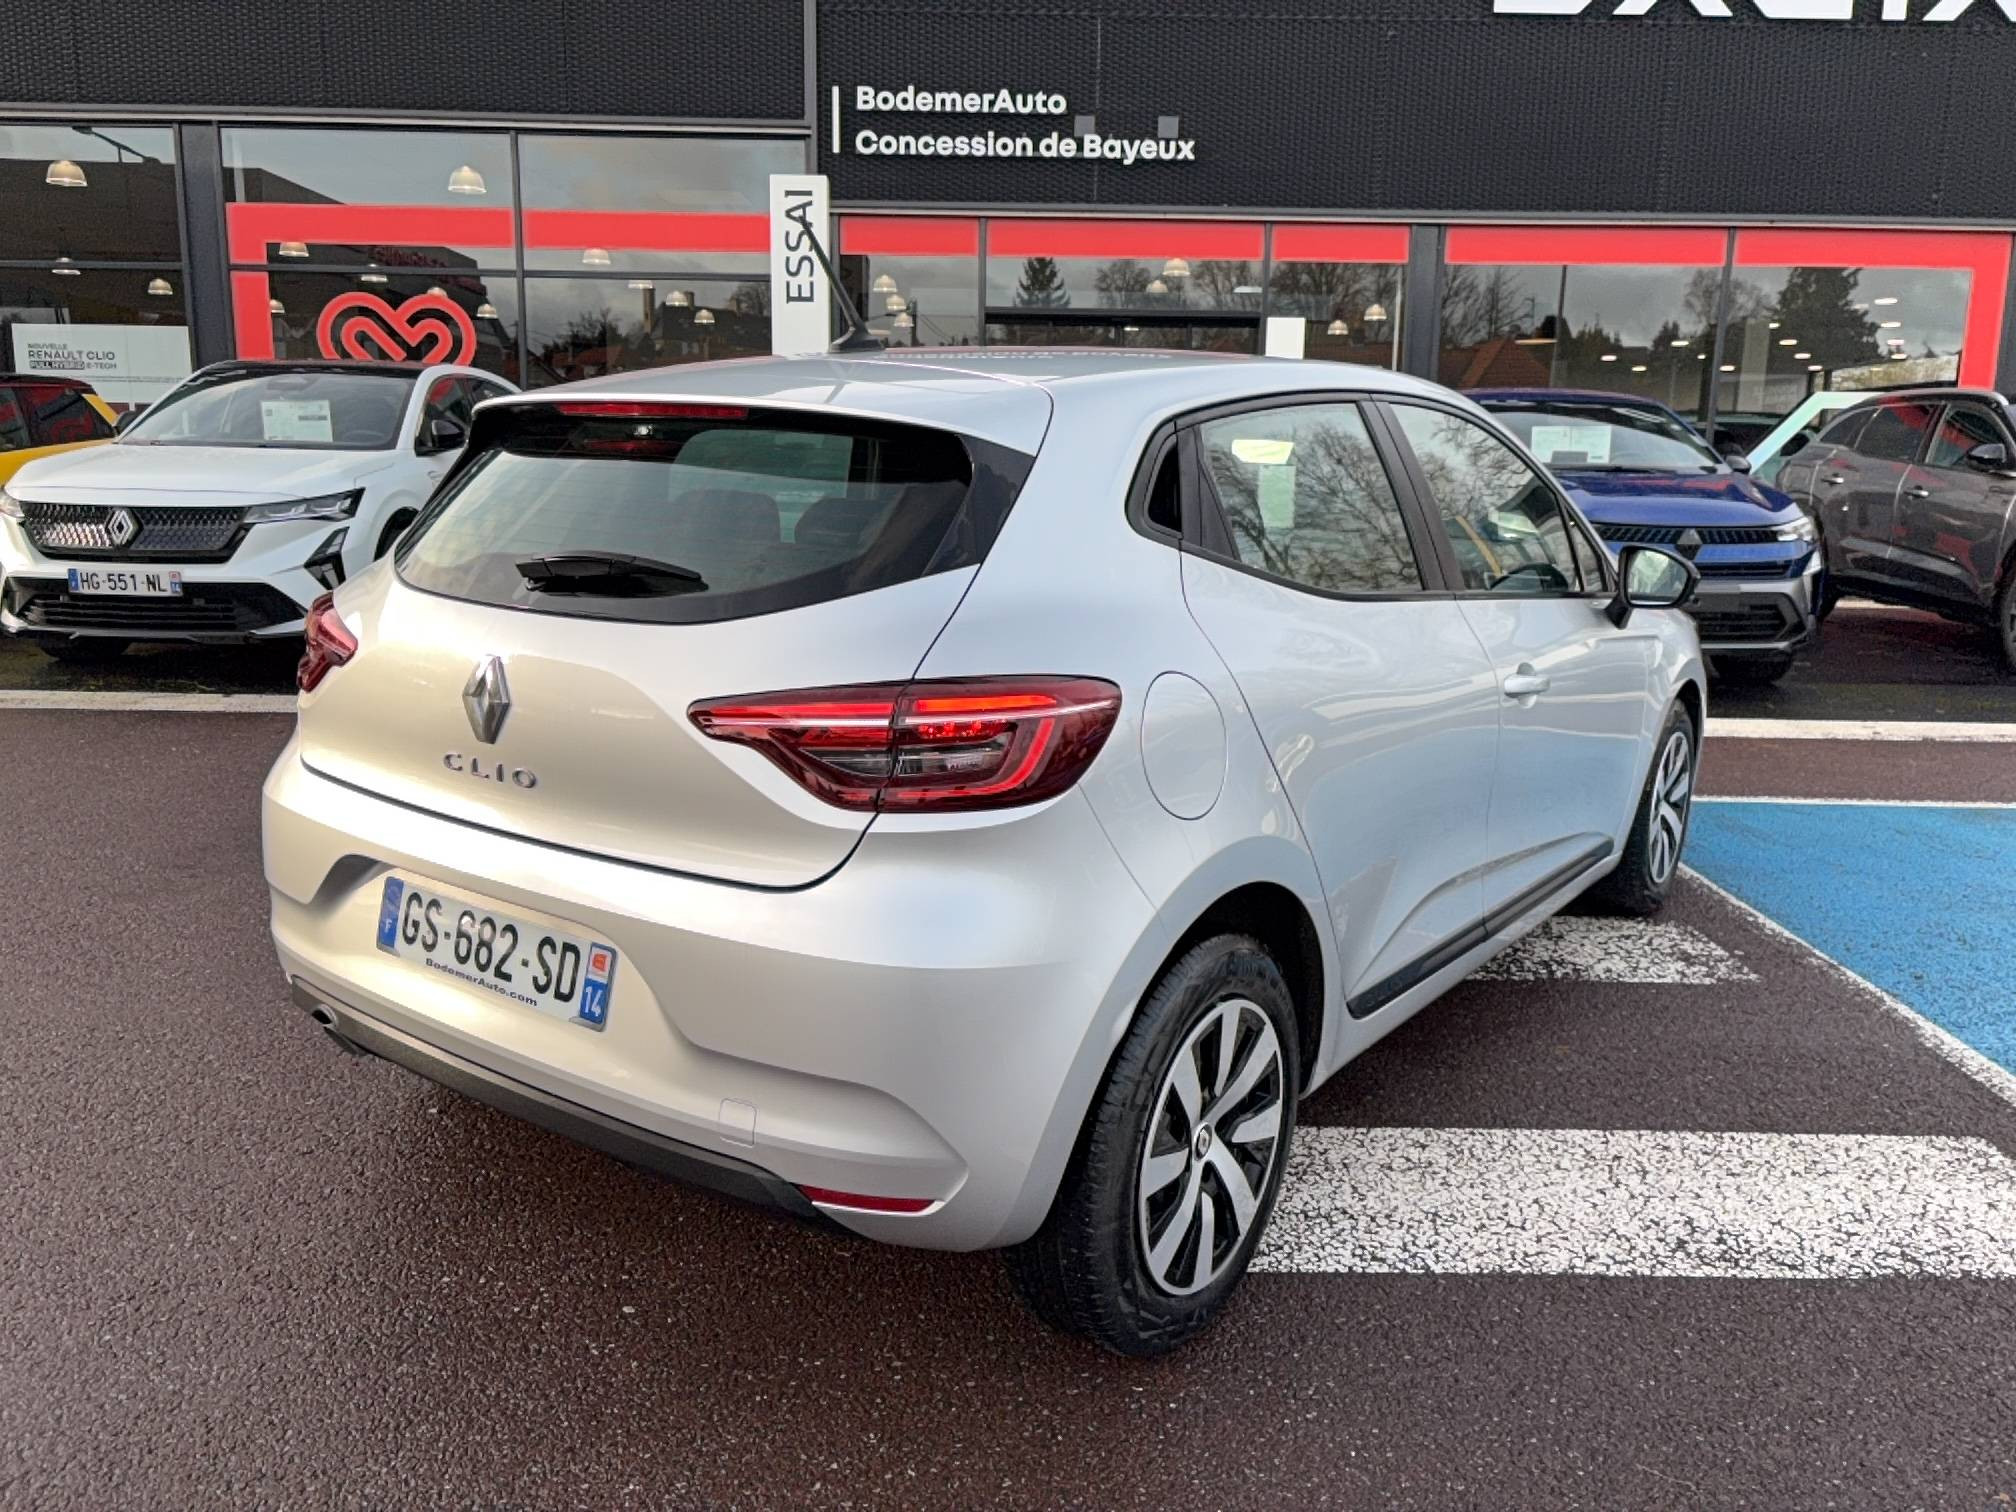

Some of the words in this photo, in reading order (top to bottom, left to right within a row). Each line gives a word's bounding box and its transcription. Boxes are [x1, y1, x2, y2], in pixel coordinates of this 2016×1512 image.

[856, 85, 1067, 114] BodemerAuto
[855, 130, 1033, 156] Concession
[1039, 132, 1077, 158] de
[1083, 133, 1195, 165] Bayeux
[785, 190, 815, 304] ESSAI
[28, 350, 83, 361] RENAULT
[86, 351, 115, 361] CLIO
[80, 572, 168, 592] HG-551-NL
[443, 752, 537, 789] CLIO
[384, 919, 393, 932] F
[402, 892, 580, 1002] GS-682-SD
[425, 957, 537, 1007] BodemerAuto.com
[584, 986, 603, 1017] 14
